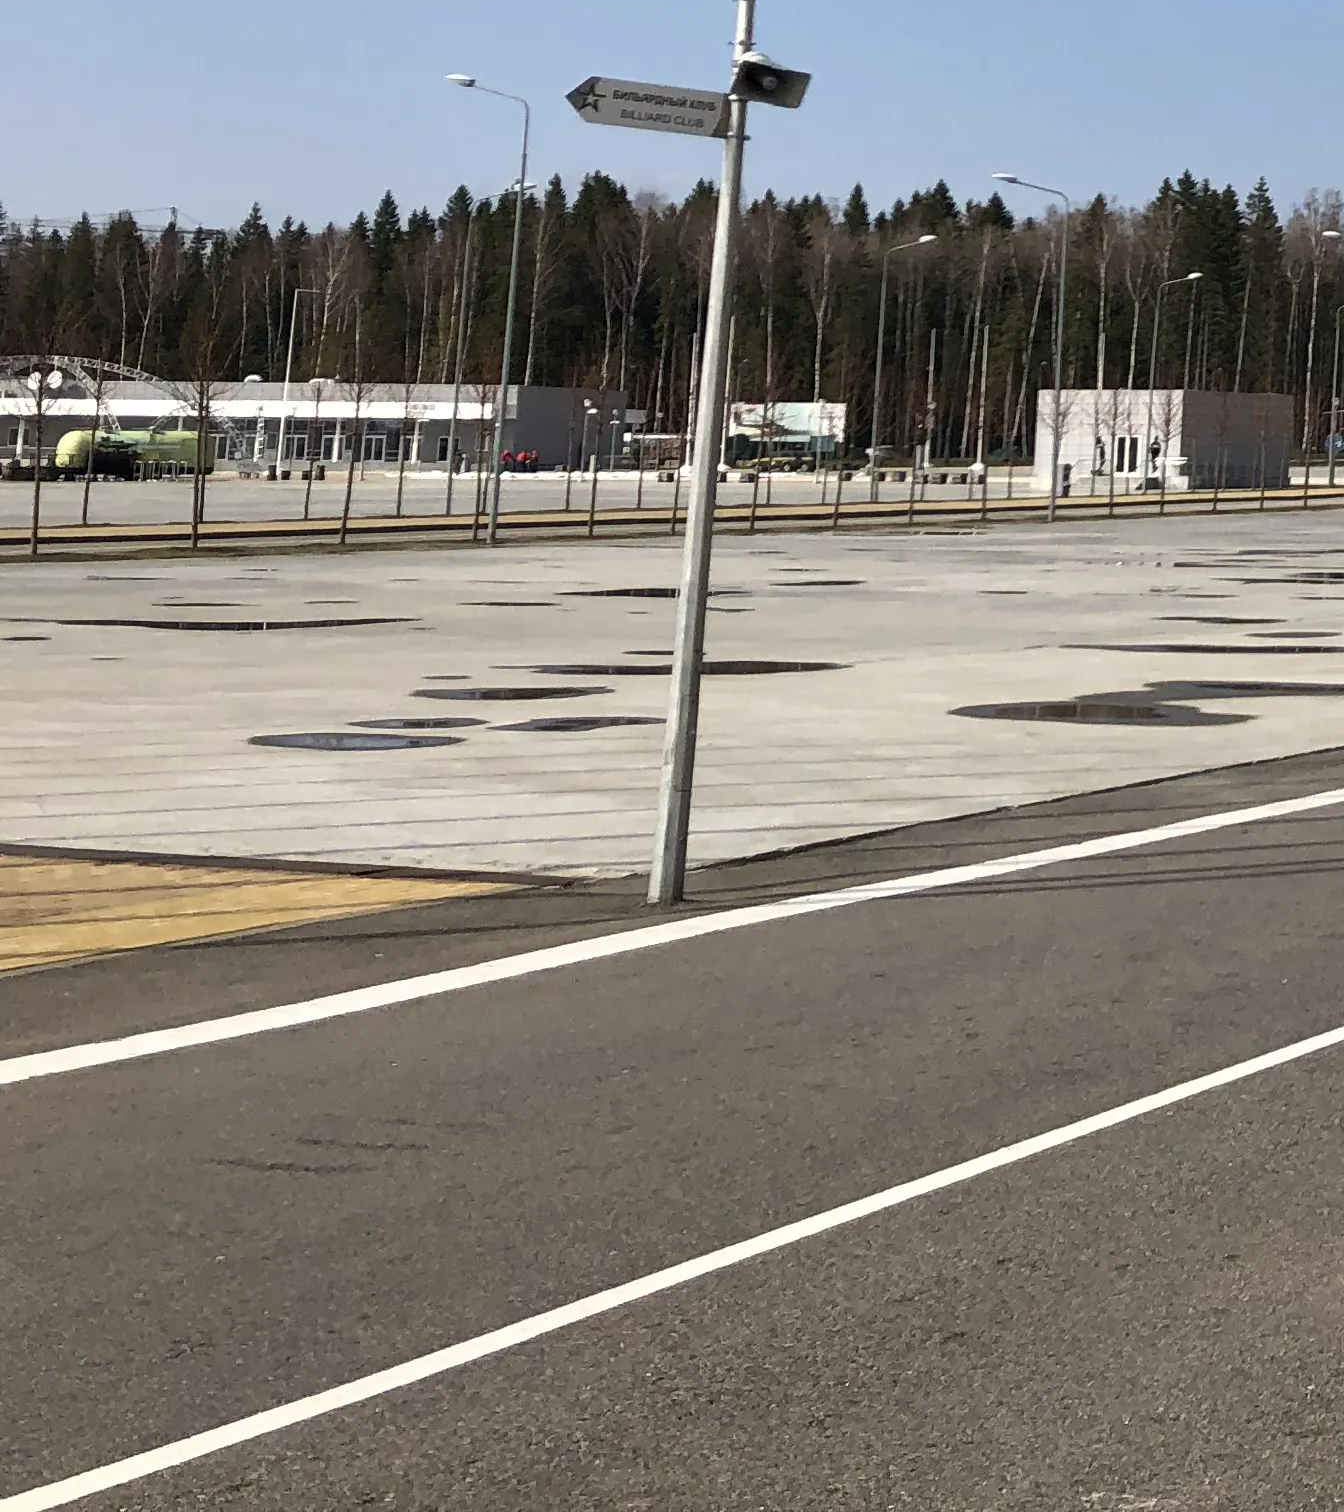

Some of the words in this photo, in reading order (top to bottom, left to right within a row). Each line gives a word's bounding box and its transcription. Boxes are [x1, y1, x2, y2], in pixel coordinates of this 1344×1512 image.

[613, 89, 688, 108] БИЛЬЯРДНЫЙ
[689, 99, 717, 112] КЛУБ
[620, 108, 671, 124] BILLIARD
[673, 115, 705, 129] CLUB
